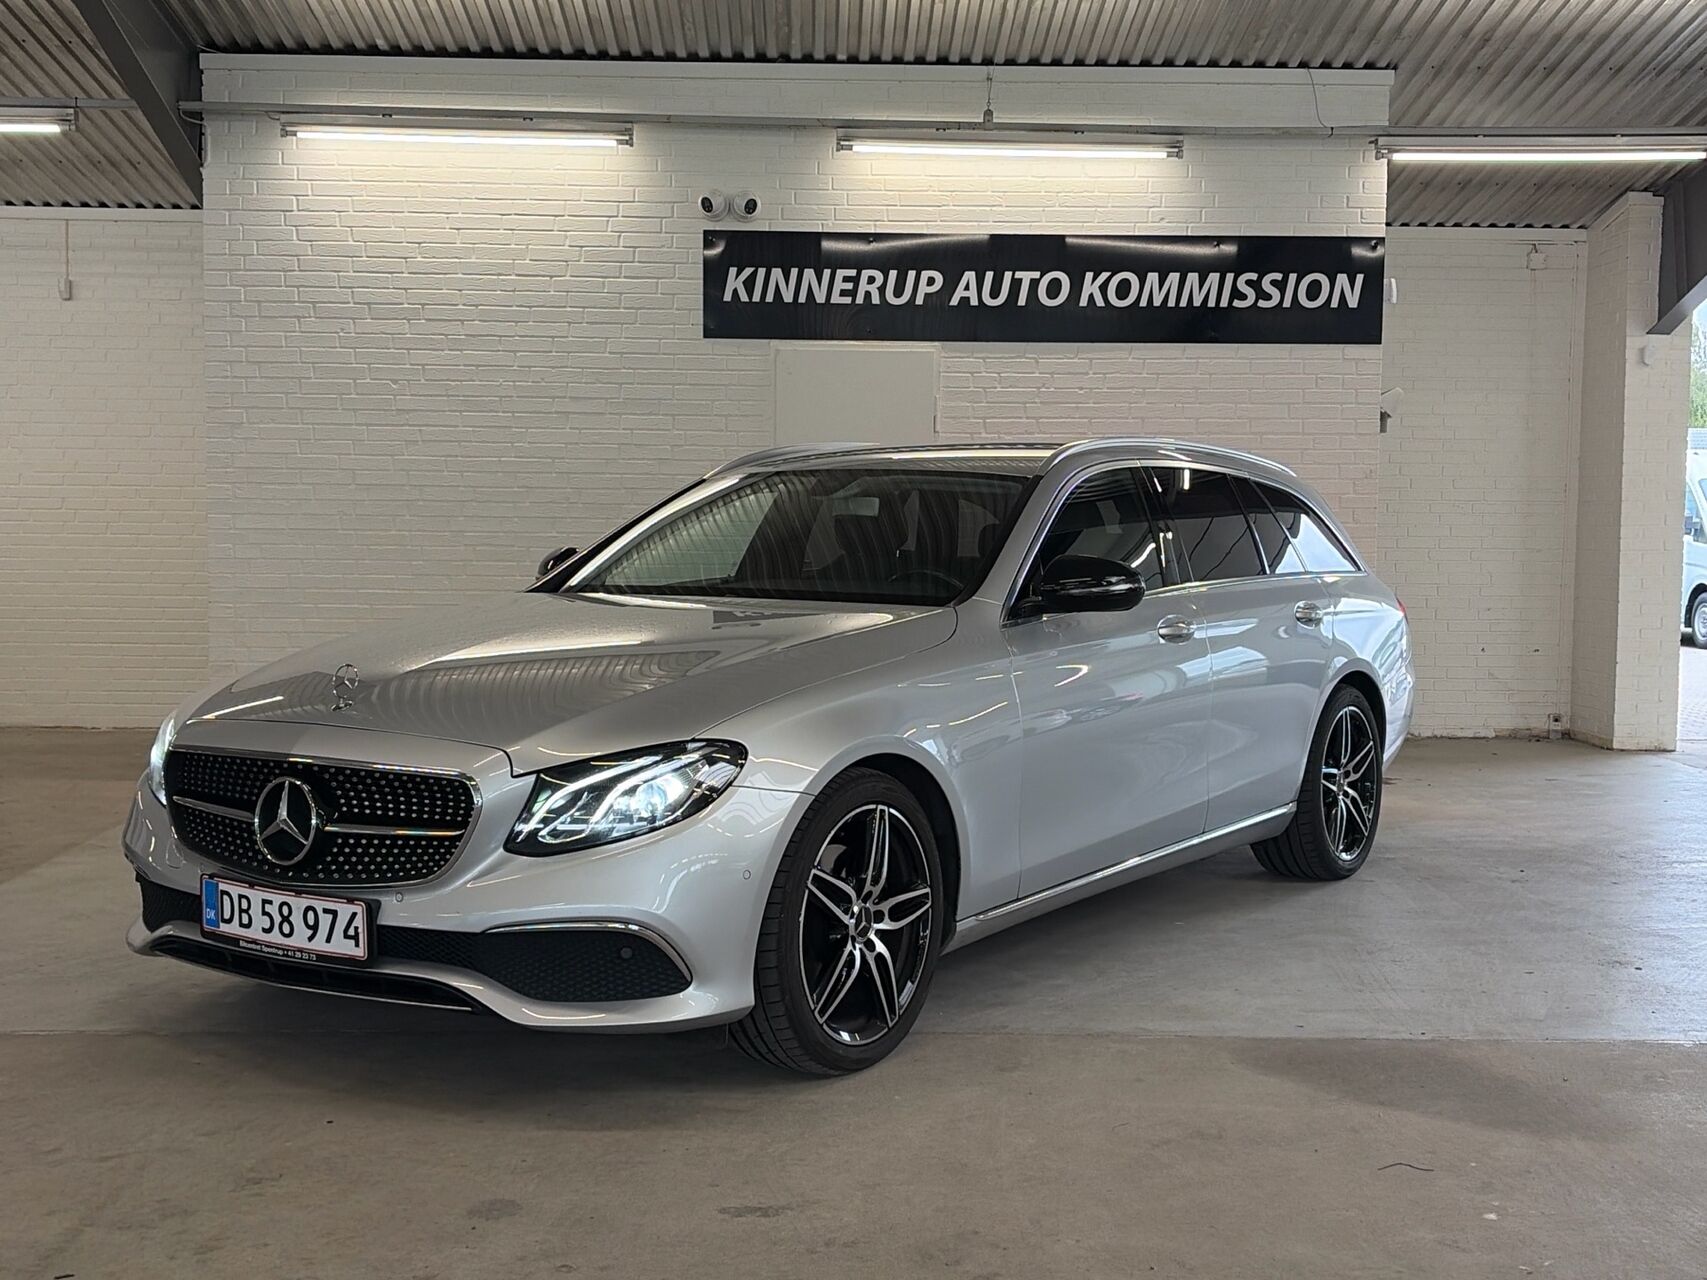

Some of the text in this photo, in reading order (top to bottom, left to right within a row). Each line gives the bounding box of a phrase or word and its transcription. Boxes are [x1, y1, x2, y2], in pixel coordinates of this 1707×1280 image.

[723, 266, 1365, 310] KINNERUP AUTO KOMMISSION
[206, 908, 216, 920] DK
[220, 889, 360, 948] DB 58 974
